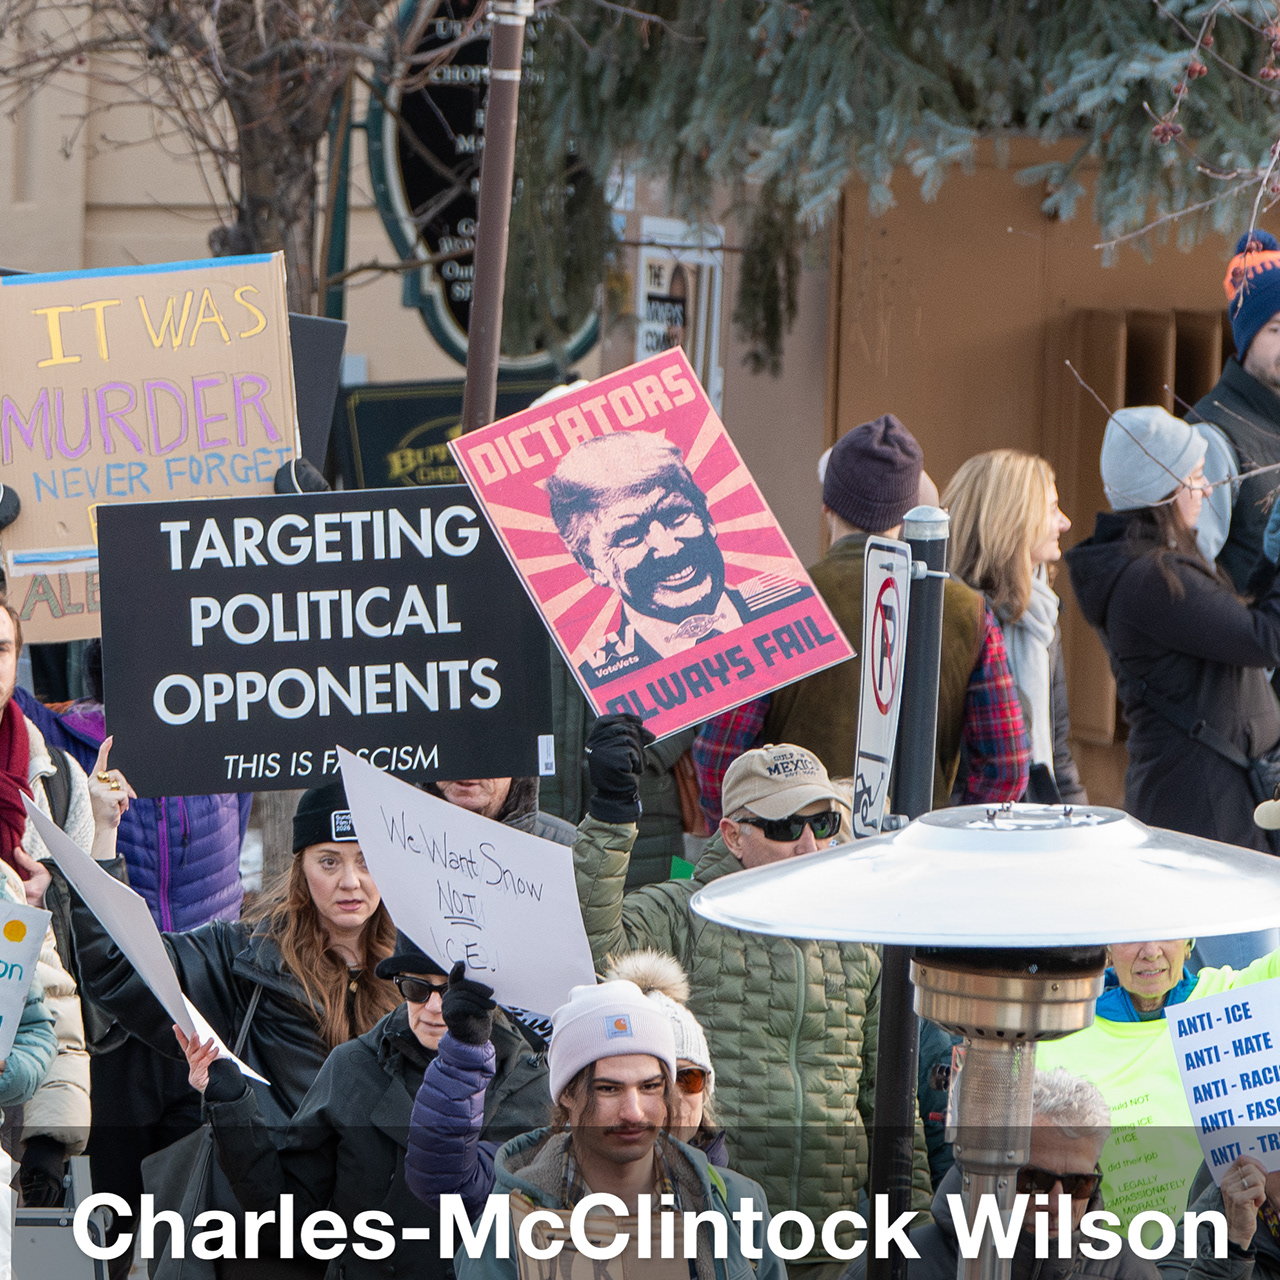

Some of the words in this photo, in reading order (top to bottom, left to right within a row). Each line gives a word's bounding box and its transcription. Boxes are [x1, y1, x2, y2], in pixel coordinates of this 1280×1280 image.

[30, 299, 122, 367] IT
[137, 284, 269, 351] WAS
[1, 373, 284, 465] MURDER
[467, 363, 697, 487] DICTATORS
[32, 461, 151, 502] NEVER
[164, 446, 295, 495] FORGET
[159, 504, 480, 571] TARGETING
[189, 583, 462, 647] POLITICAL
[594, 653, 640, 679] VoteVets
[605, 649, 757, 723] ALWAYS
[752, 615, 836, 669] FAIL
[152, 657, 502, 726] OPPONENTS
[223, 753, 280, 781] THIS
[289, 751, 313, 778] IS
[379, 804, 422, 855] We
[418, 824, 480, 879] Want
[479, 842, 543, 903] Snow
[436, 879, 477, 916] NOT
[1177, 1012, 1214, 1038] ANTI
[1224, 1001, 1253, 1024] ICE
[1185, 1045, 1221, 1072] ANTI
[1232, 1031, 1273, 1058] HATE
[1110, 1102, 1127, 1112] ould
[1130, 1094, 1150, 1107] NOT
[1192, 1078, 1228, 1105] ANTI
[1239, 1065, 1280, 1091] RACI
[1122, 1132, 1138, 1144] ICE
[1138, 1116, 1153, 1127] ICE
[1200, 1109, 1235, 1135] ANTI
[1144, 1151, 1158, 1164] job
[1210, 1142, 1241, 1168] ANTI
[1256, 1132, 1280, 1154] TR
[1104, 1178, 1187, 1209] OMPASSIONATELY
[1118, 1174, 1159, 1192] LEGALLY
[1122, 1196, 1166, 1216] MORALLY
